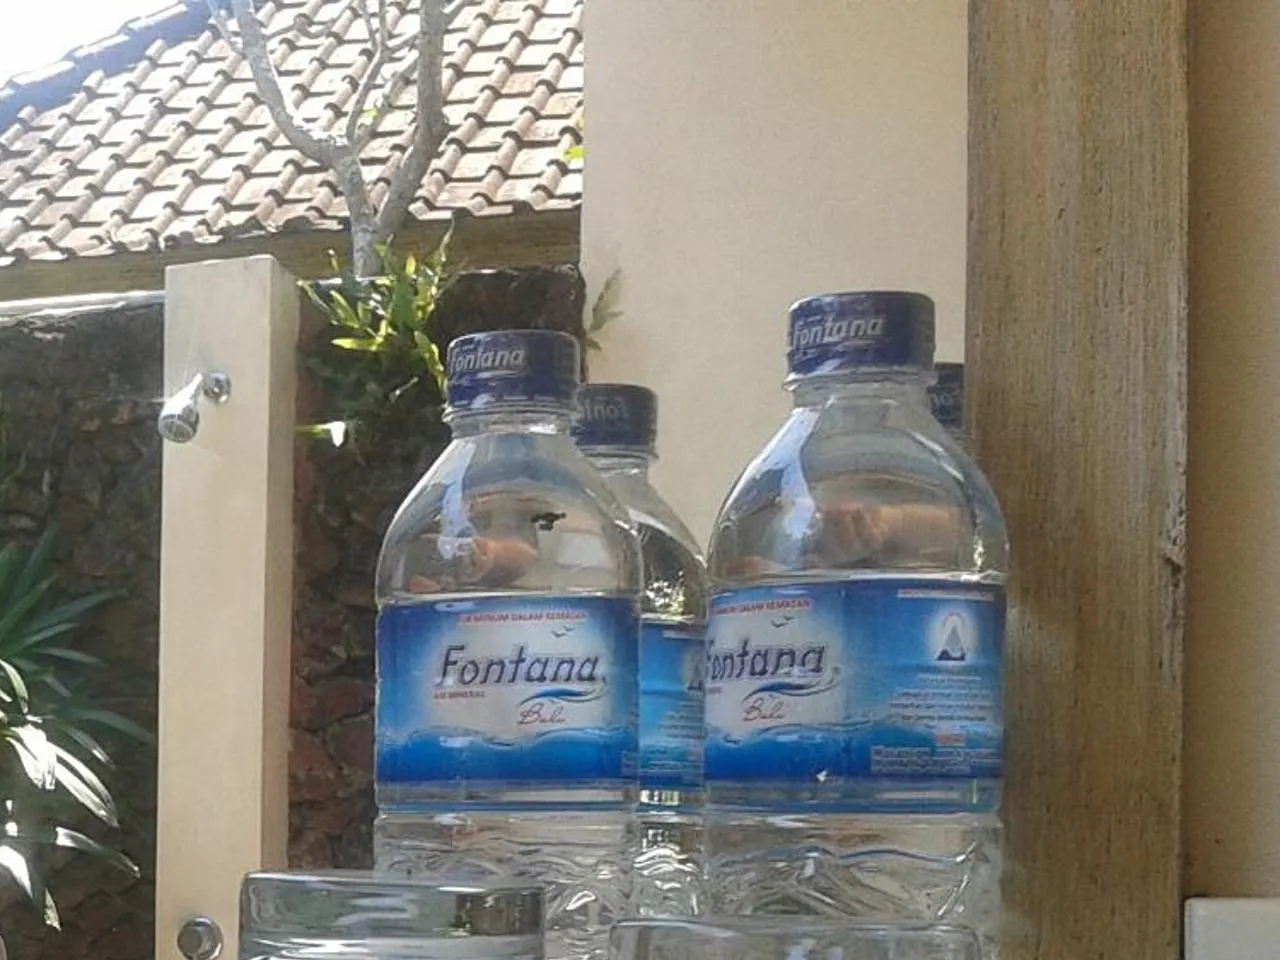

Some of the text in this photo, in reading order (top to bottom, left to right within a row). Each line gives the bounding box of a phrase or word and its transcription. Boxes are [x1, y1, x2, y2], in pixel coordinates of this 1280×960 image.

[791, 313, 884, 349] Fontana
[450, 345, 524, 374] Fontana
[436, 643, 599, 688] Fontana
